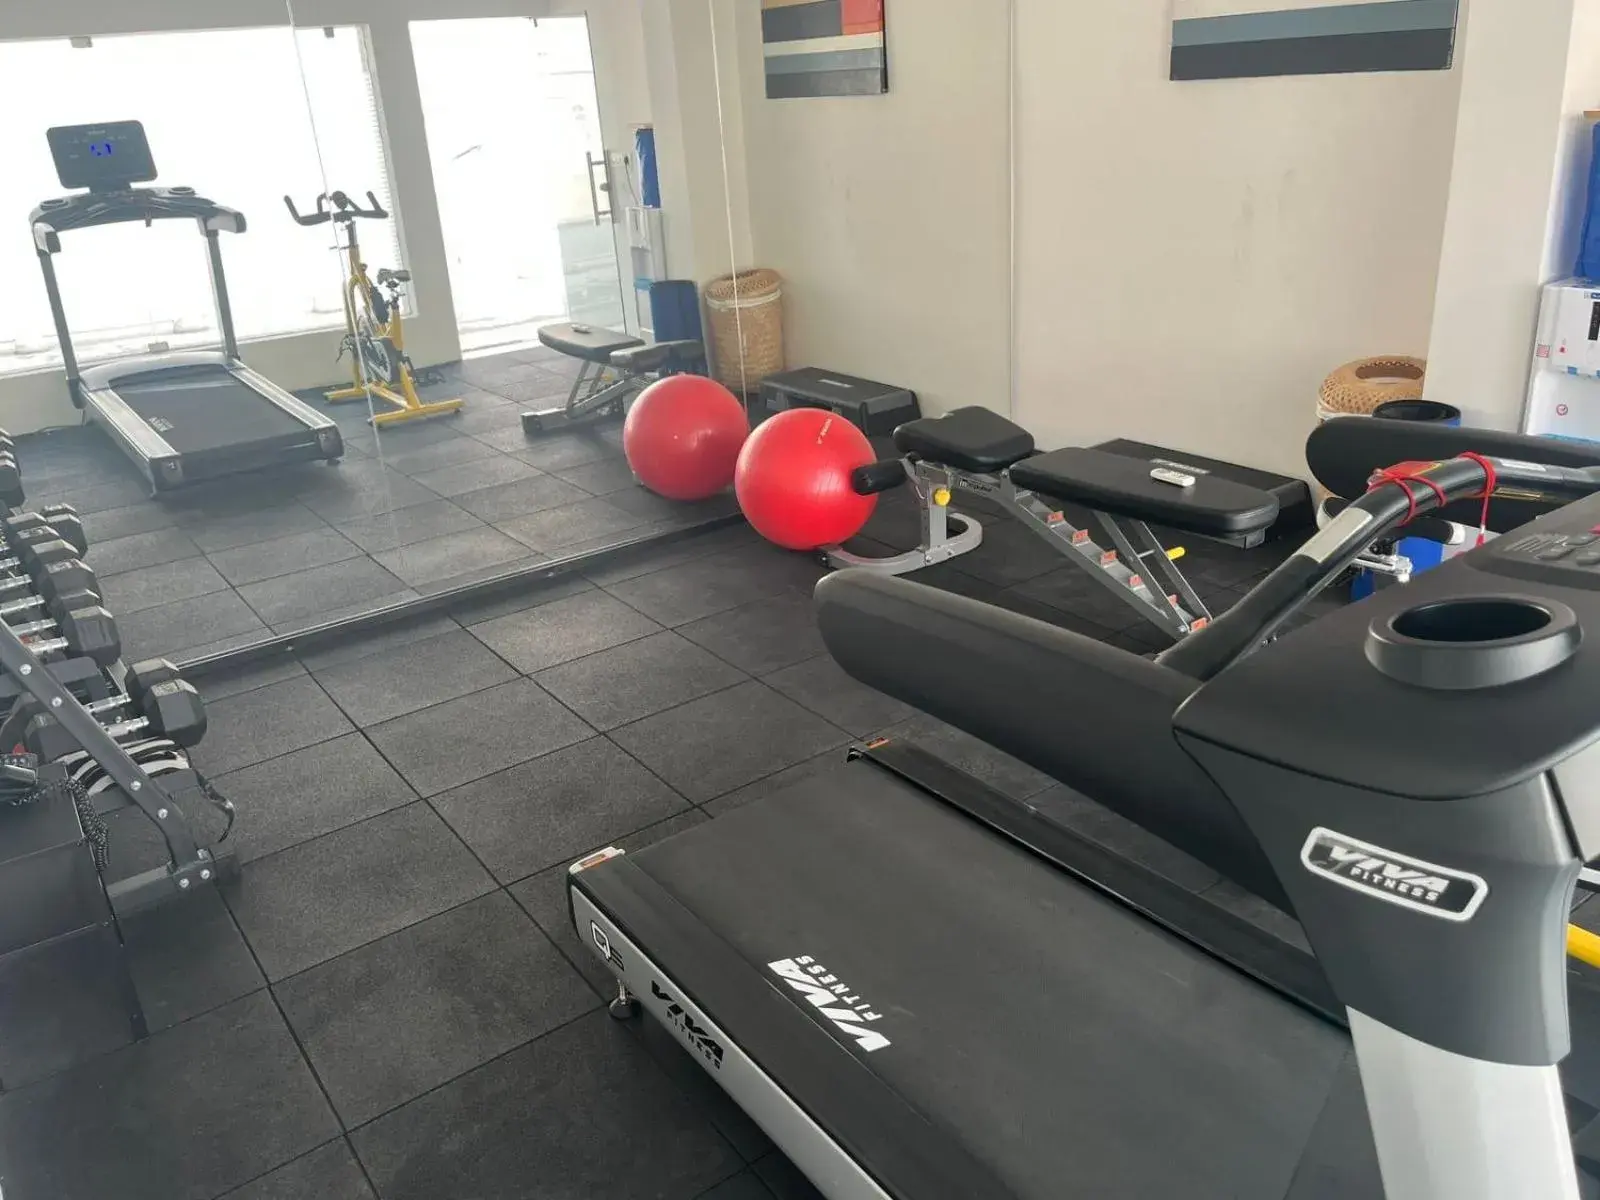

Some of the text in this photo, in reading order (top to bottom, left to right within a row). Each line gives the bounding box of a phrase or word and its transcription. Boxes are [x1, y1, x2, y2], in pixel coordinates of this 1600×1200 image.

[1329, 845, 1450, 893] VIVA
[1350, 866, 1440, 901] FITNESS
[767, 958, 891, 1052] VIVA
[795, 955, 883, 1021] FITNESS
[651, 980, 724, 1061] VIVA
[666, 1010, 720, 1069] FITNESS
